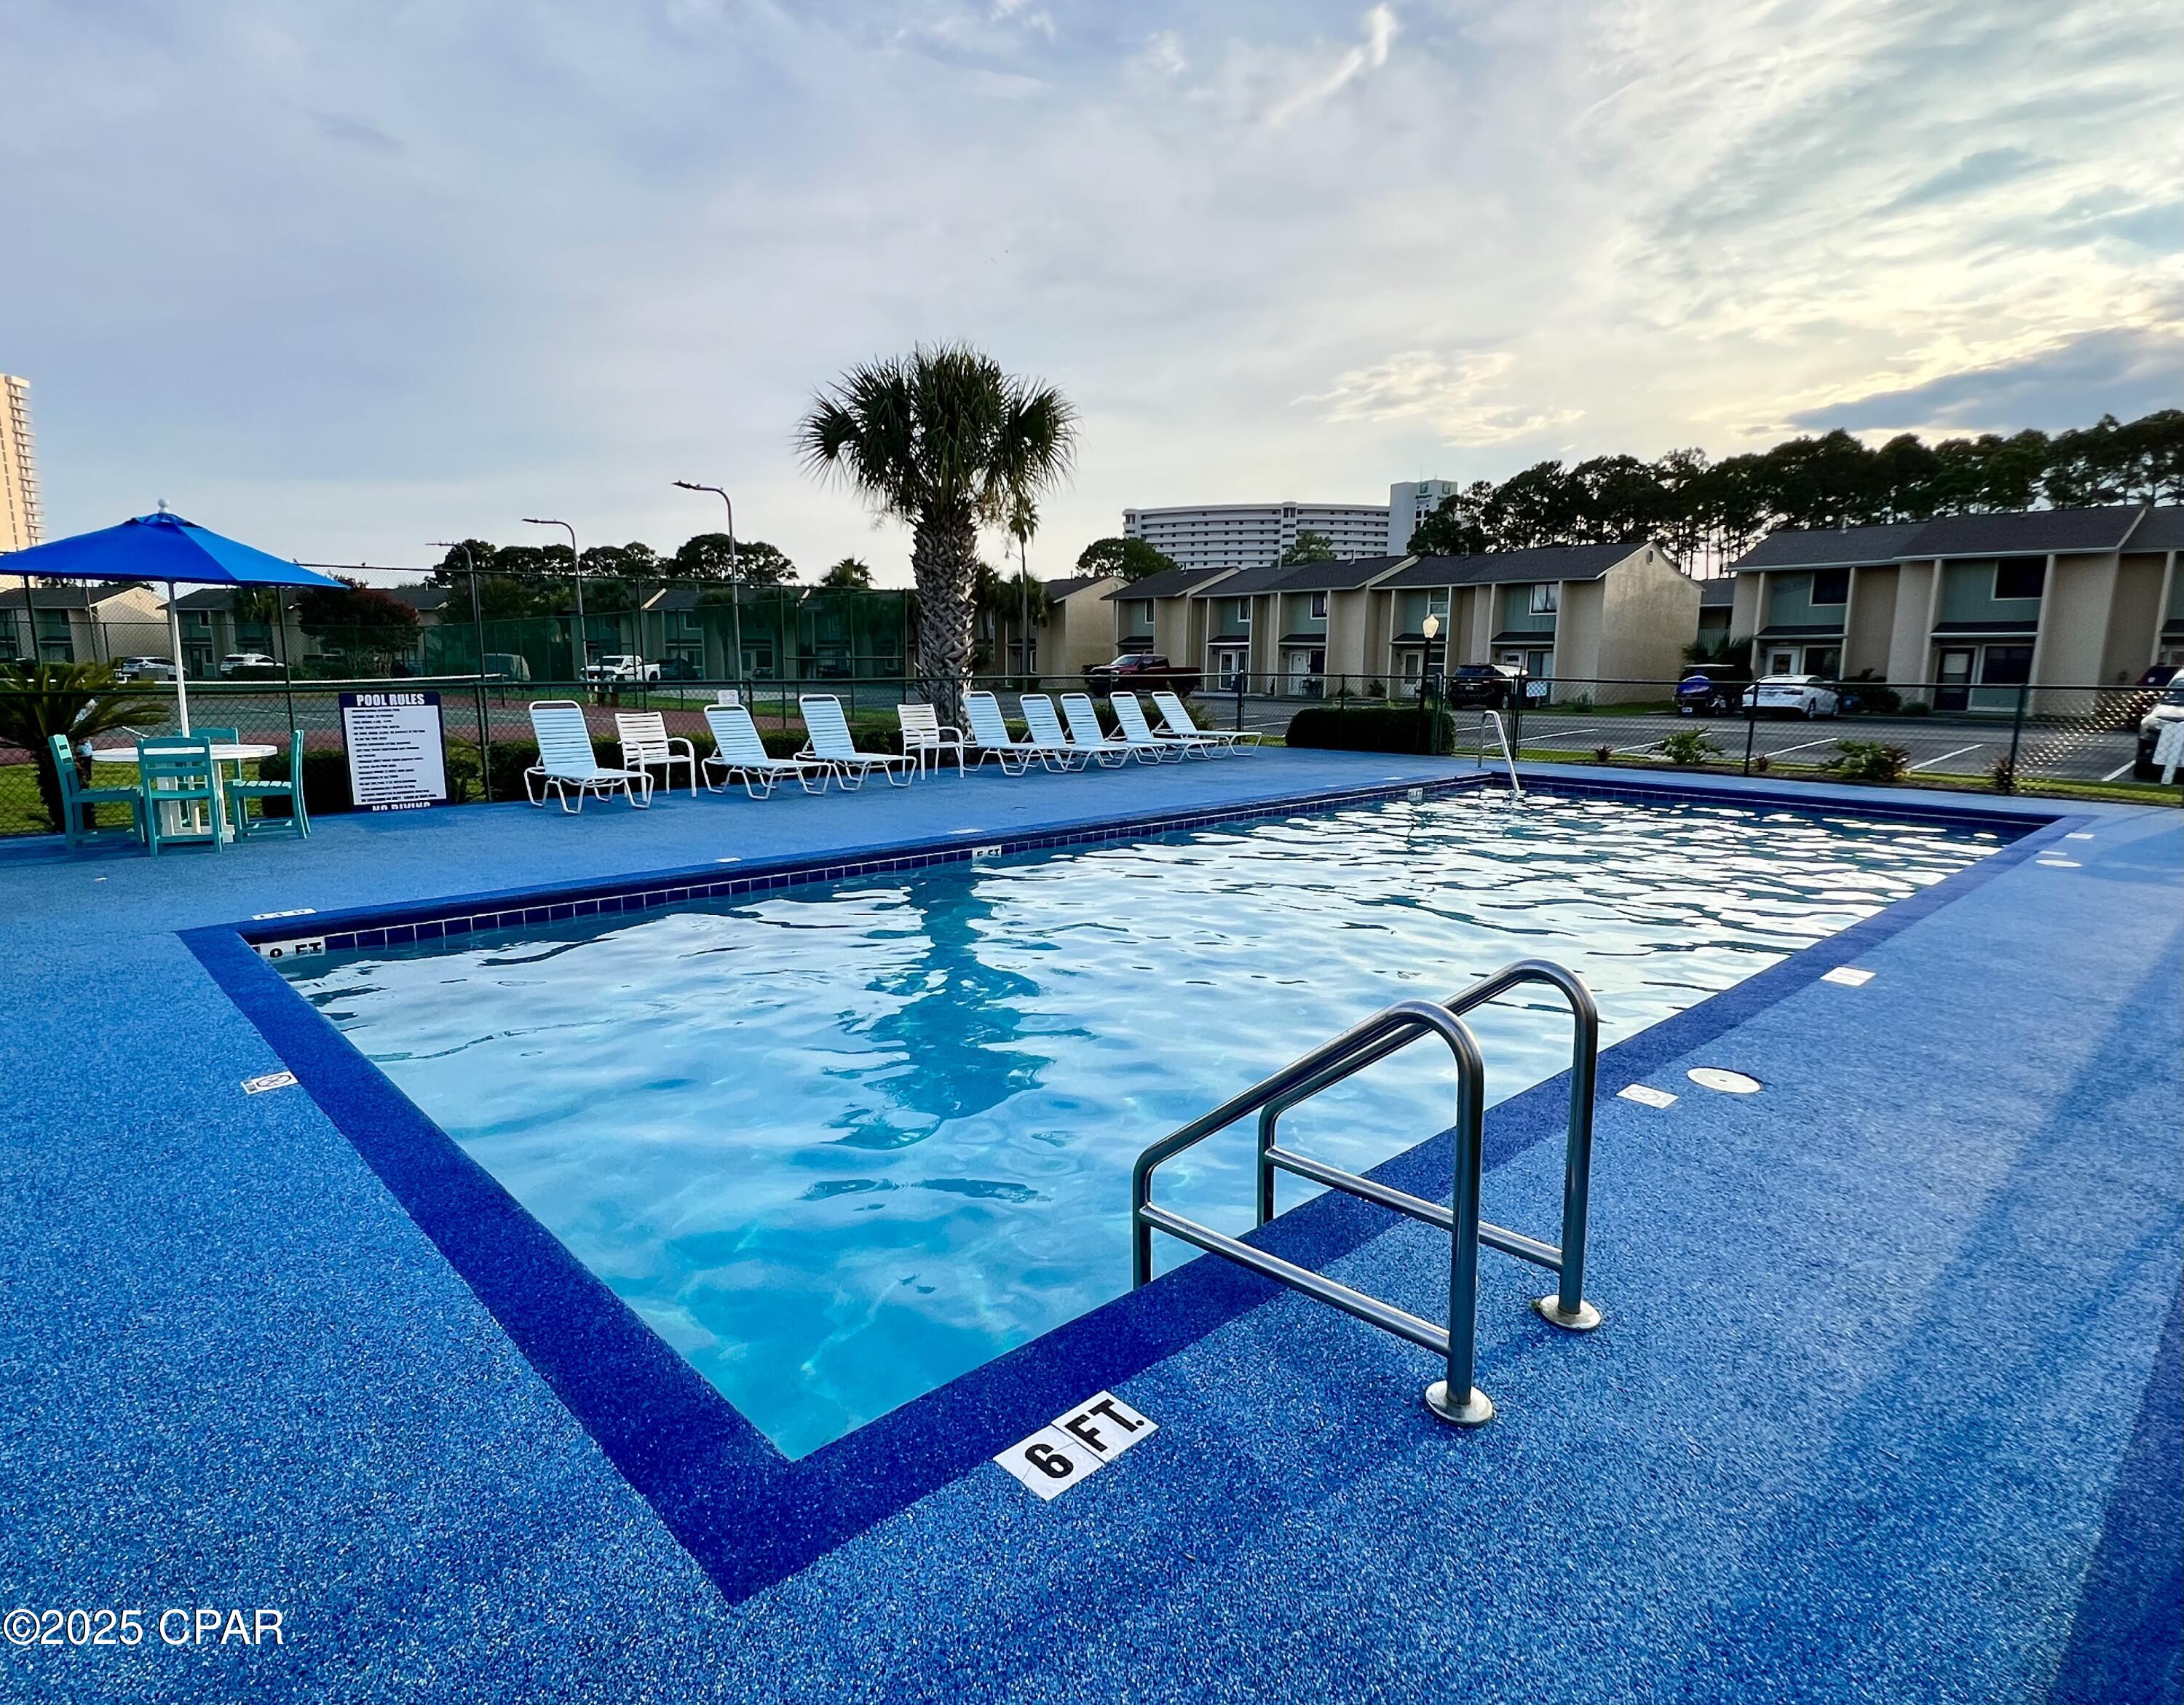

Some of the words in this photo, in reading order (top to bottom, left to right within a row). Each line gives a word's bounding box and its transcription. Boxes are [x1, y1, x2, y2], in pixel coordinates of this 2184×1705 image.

[356, 695, 387, 706] POOL
[389, 694, 425, 705] RULES
[1024, 1444, 1074, 1479] 6
[1064, 1399, 1145, 1453] FT.
